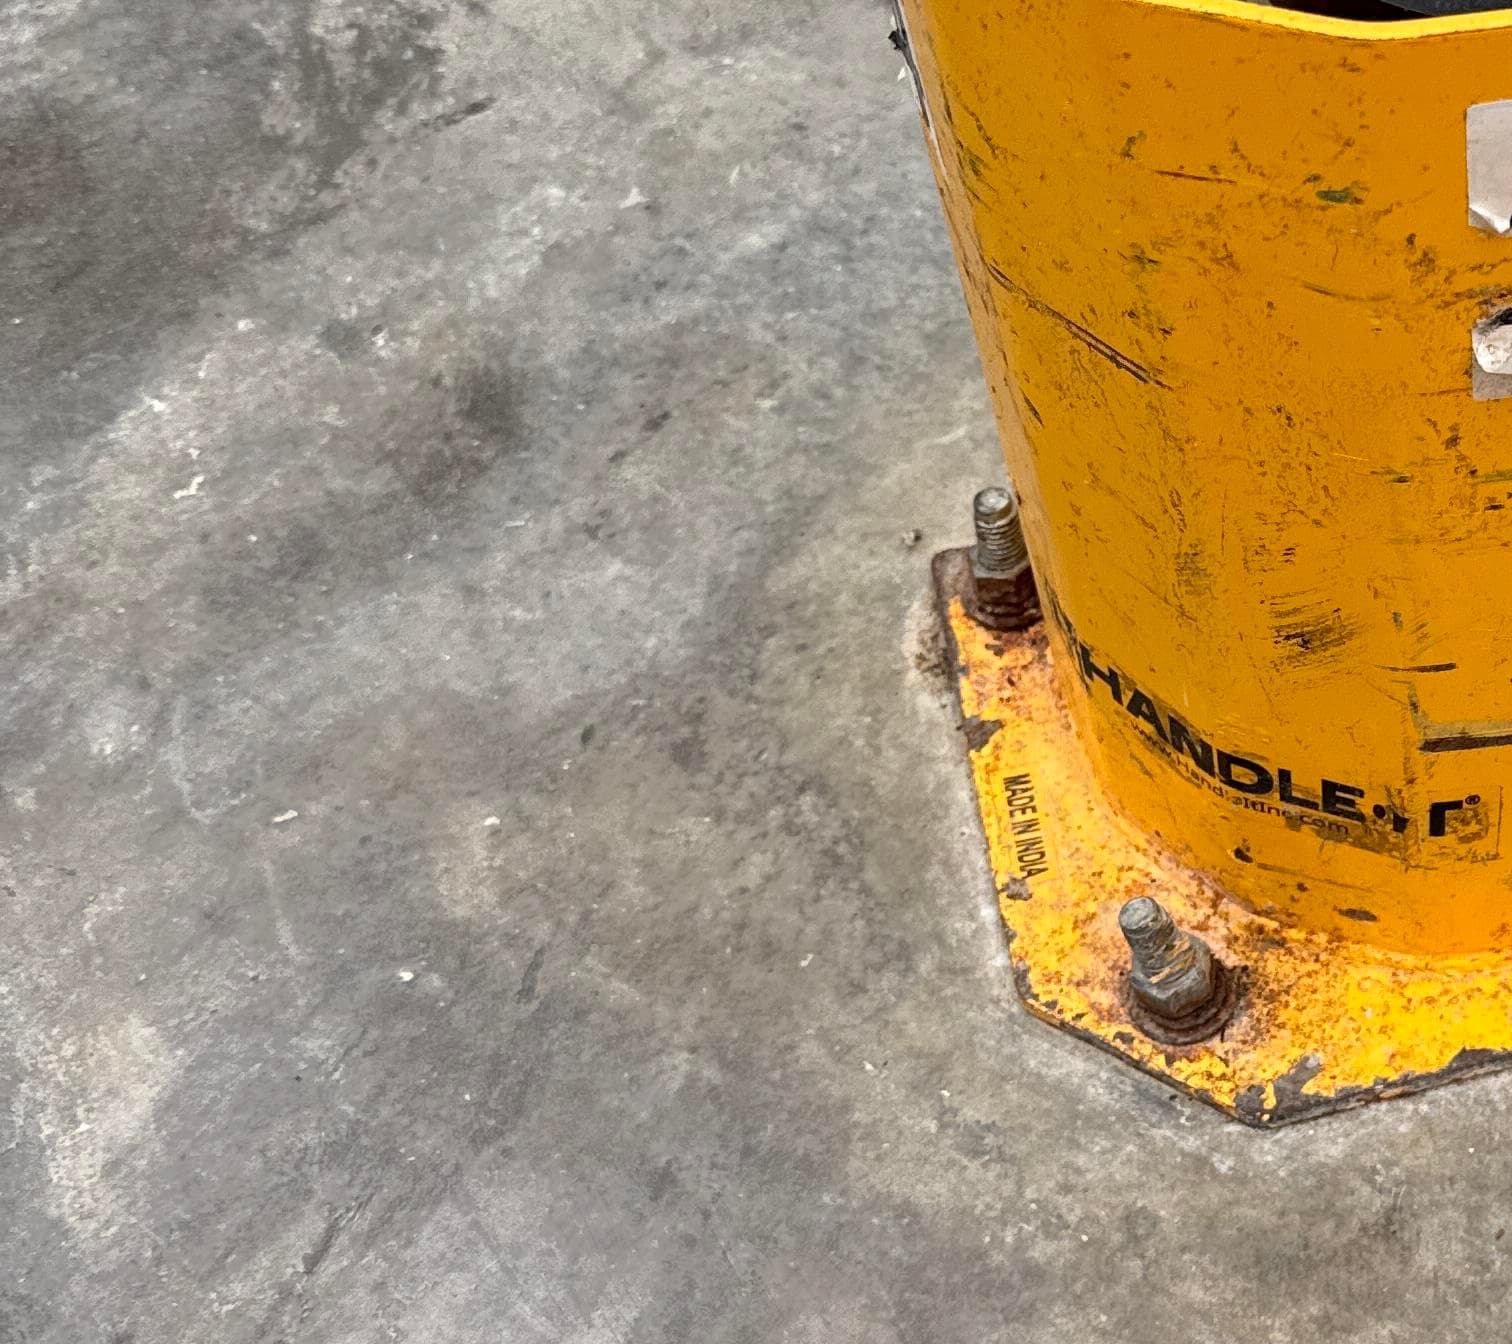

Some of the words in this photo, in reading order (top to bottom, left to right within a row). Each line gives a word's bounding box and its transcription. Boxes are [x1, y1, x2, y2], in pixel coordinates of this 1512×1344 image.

[1003, 773, 1038, 818] MADE
[1011, 818, 1041, 836] IN
[1016, 837, 1049, 880] INDIA
